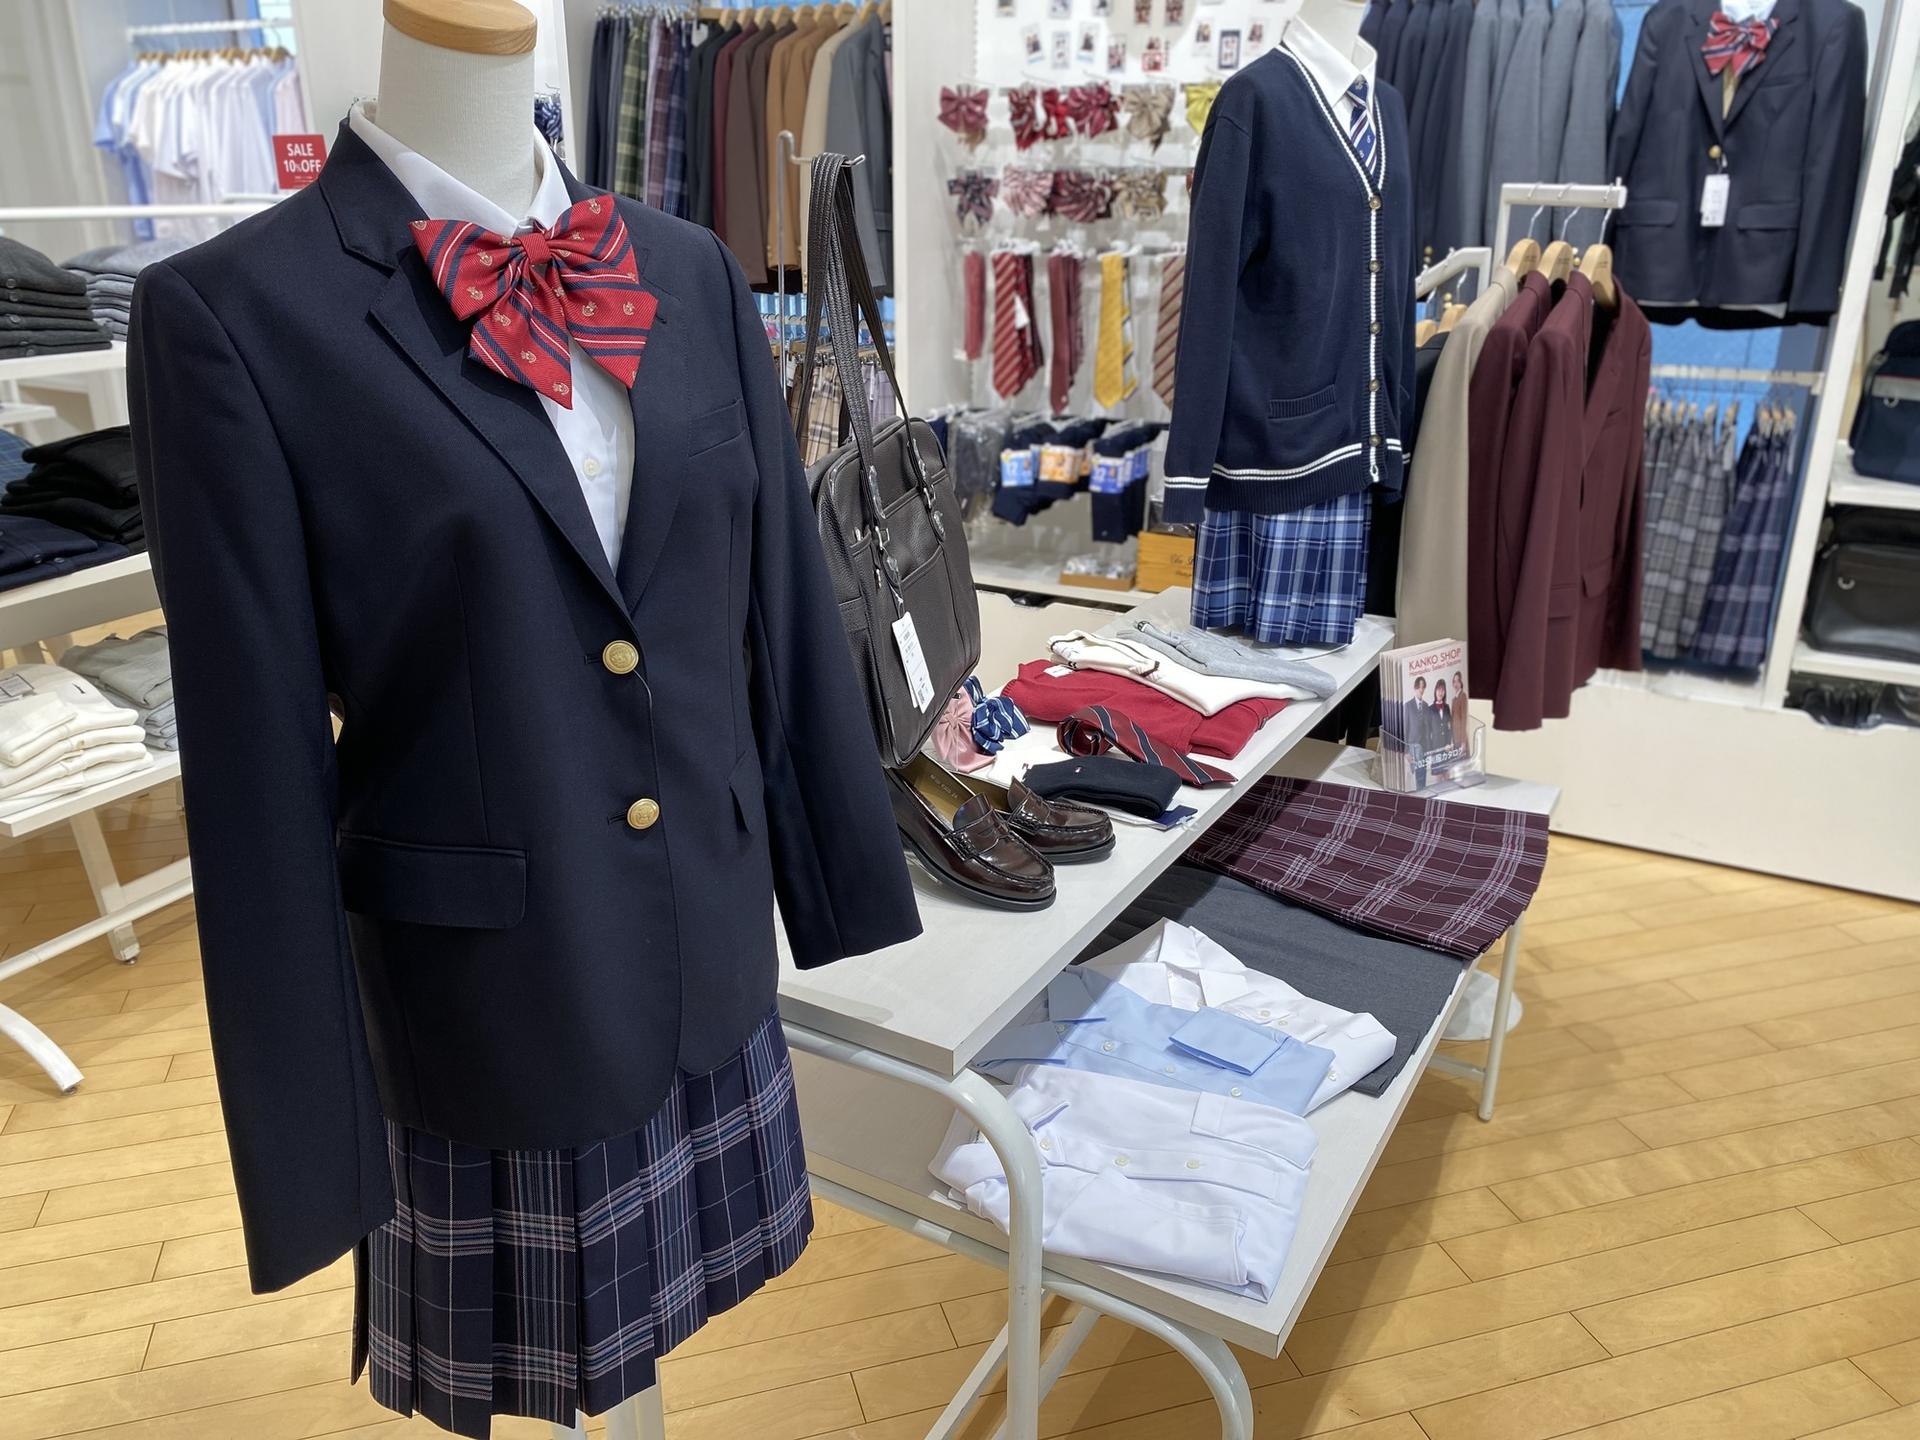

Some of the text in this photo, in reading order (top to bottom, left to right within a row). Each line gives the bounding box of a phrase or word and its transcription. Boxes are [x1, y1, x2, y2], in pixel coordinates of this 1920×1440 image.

[286, 143, 314, 157] SALE
[1408, 647, 1461, 671] KANKO SHOP
